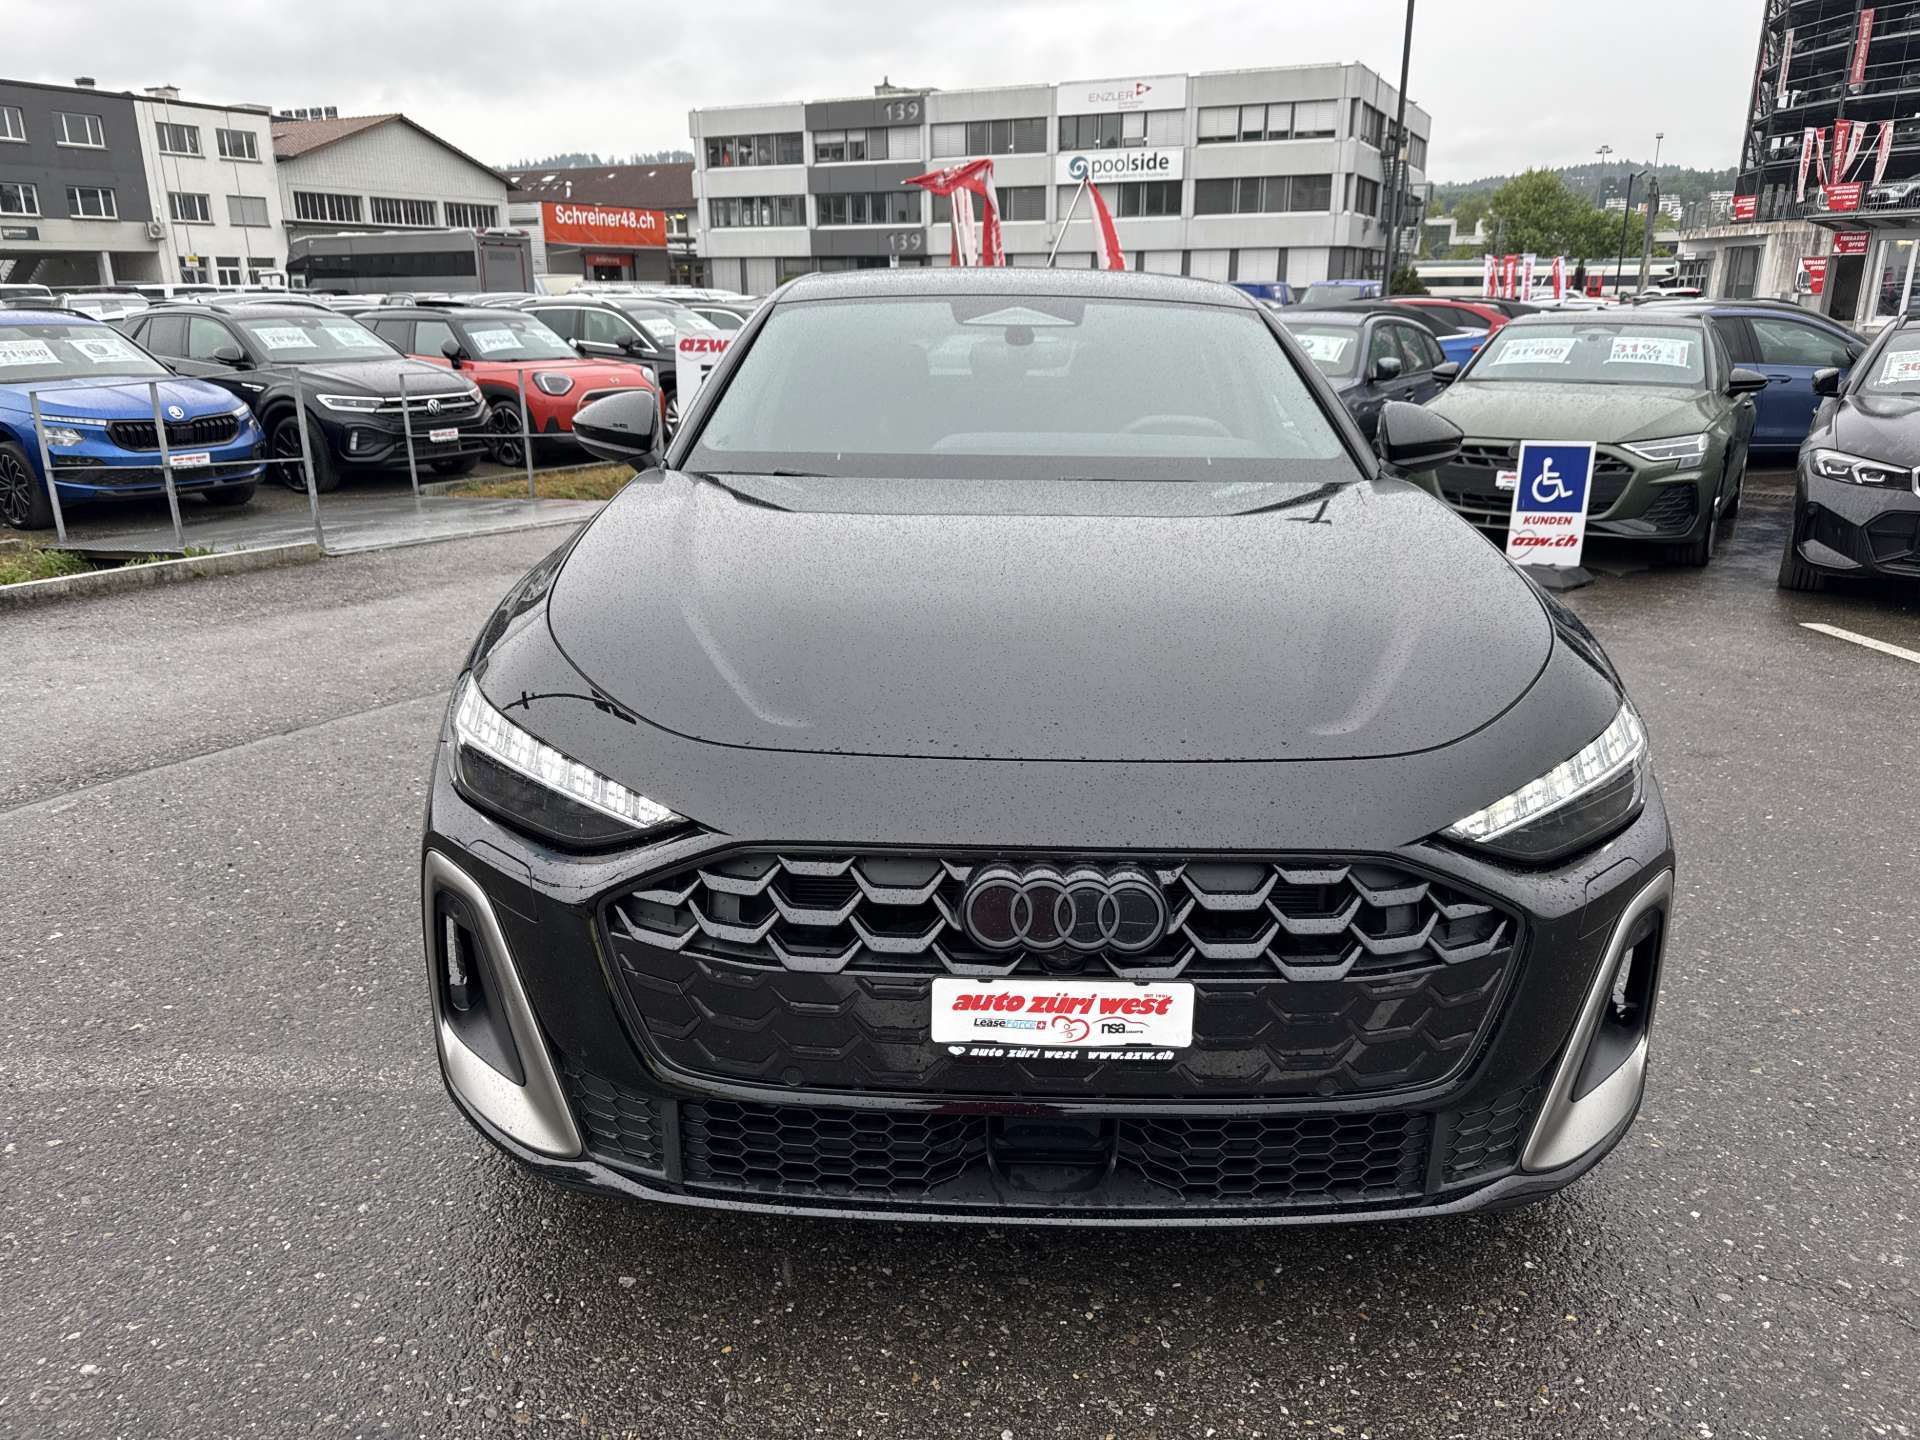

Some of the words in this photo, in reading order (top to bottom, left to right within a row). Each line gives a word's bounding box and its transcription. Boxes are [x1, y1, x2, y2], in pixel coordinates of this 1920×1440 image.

[1088, 90, 1134, 103] ENZLER
[885, 101, 920, 121] 139
[1091, 152, 1170, 180] poolside
[555, 204, 656, 229] Schreiner48.ch
[887, 232, 922, 250] 139
[1614, 343, 1662, 355] 31%
[1612, 352, 1662, 362] RABATT
[1523, 515, 1573, 526] KUNDEN
[1511, 534, 1578, 548] azw.ch
[951, 990, 1026, 1013] auto
[1027, 992, 1096, 1015] züri
[1099, 994, 1174, 1016] west
[1101, 1023, 1126, 1034] nsa
[969, 1048, 1004, 1058] auto
[1007, 1048, 1040, 1059] züri
[1044, 1049, 1079, 1060] west
[1087, 1050, 1176, 1061] www.azw.ch
